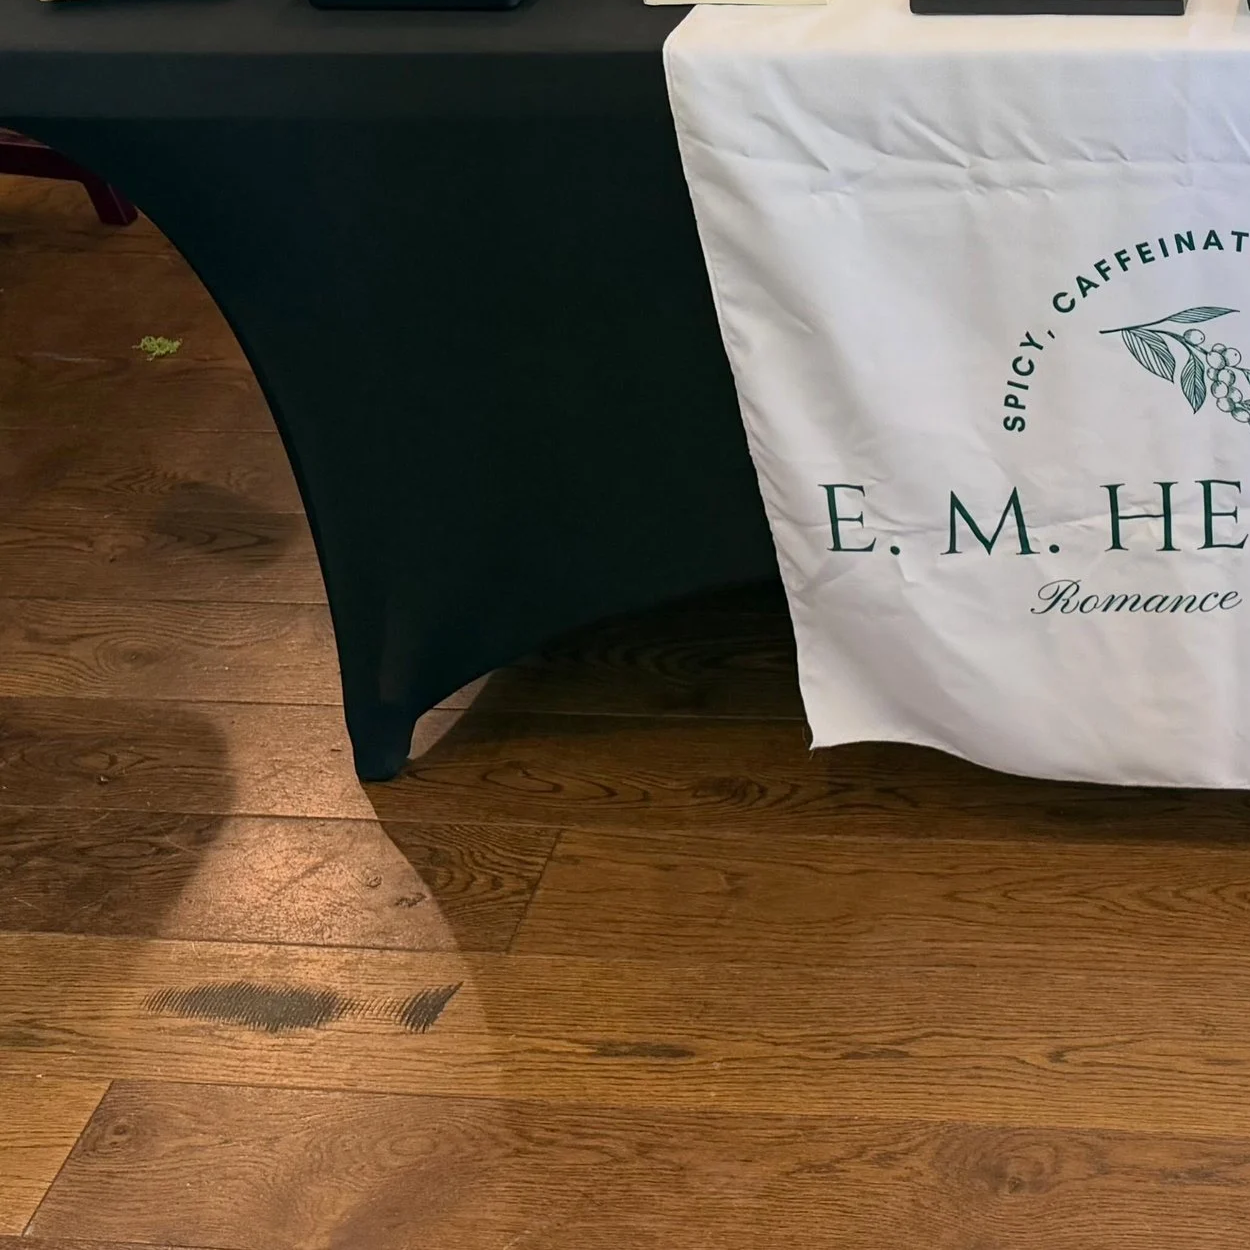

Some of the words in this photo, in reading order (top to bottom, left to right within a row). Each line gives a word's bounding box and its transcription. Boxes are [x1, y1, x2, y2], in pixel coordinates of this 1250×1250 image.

[1003, 329, 1056, 433] SPICY,
[817, 482, 902, 557] E.
[939, 484, 1062, 557] M.
[1030, 578, 1244, 617] Romance
